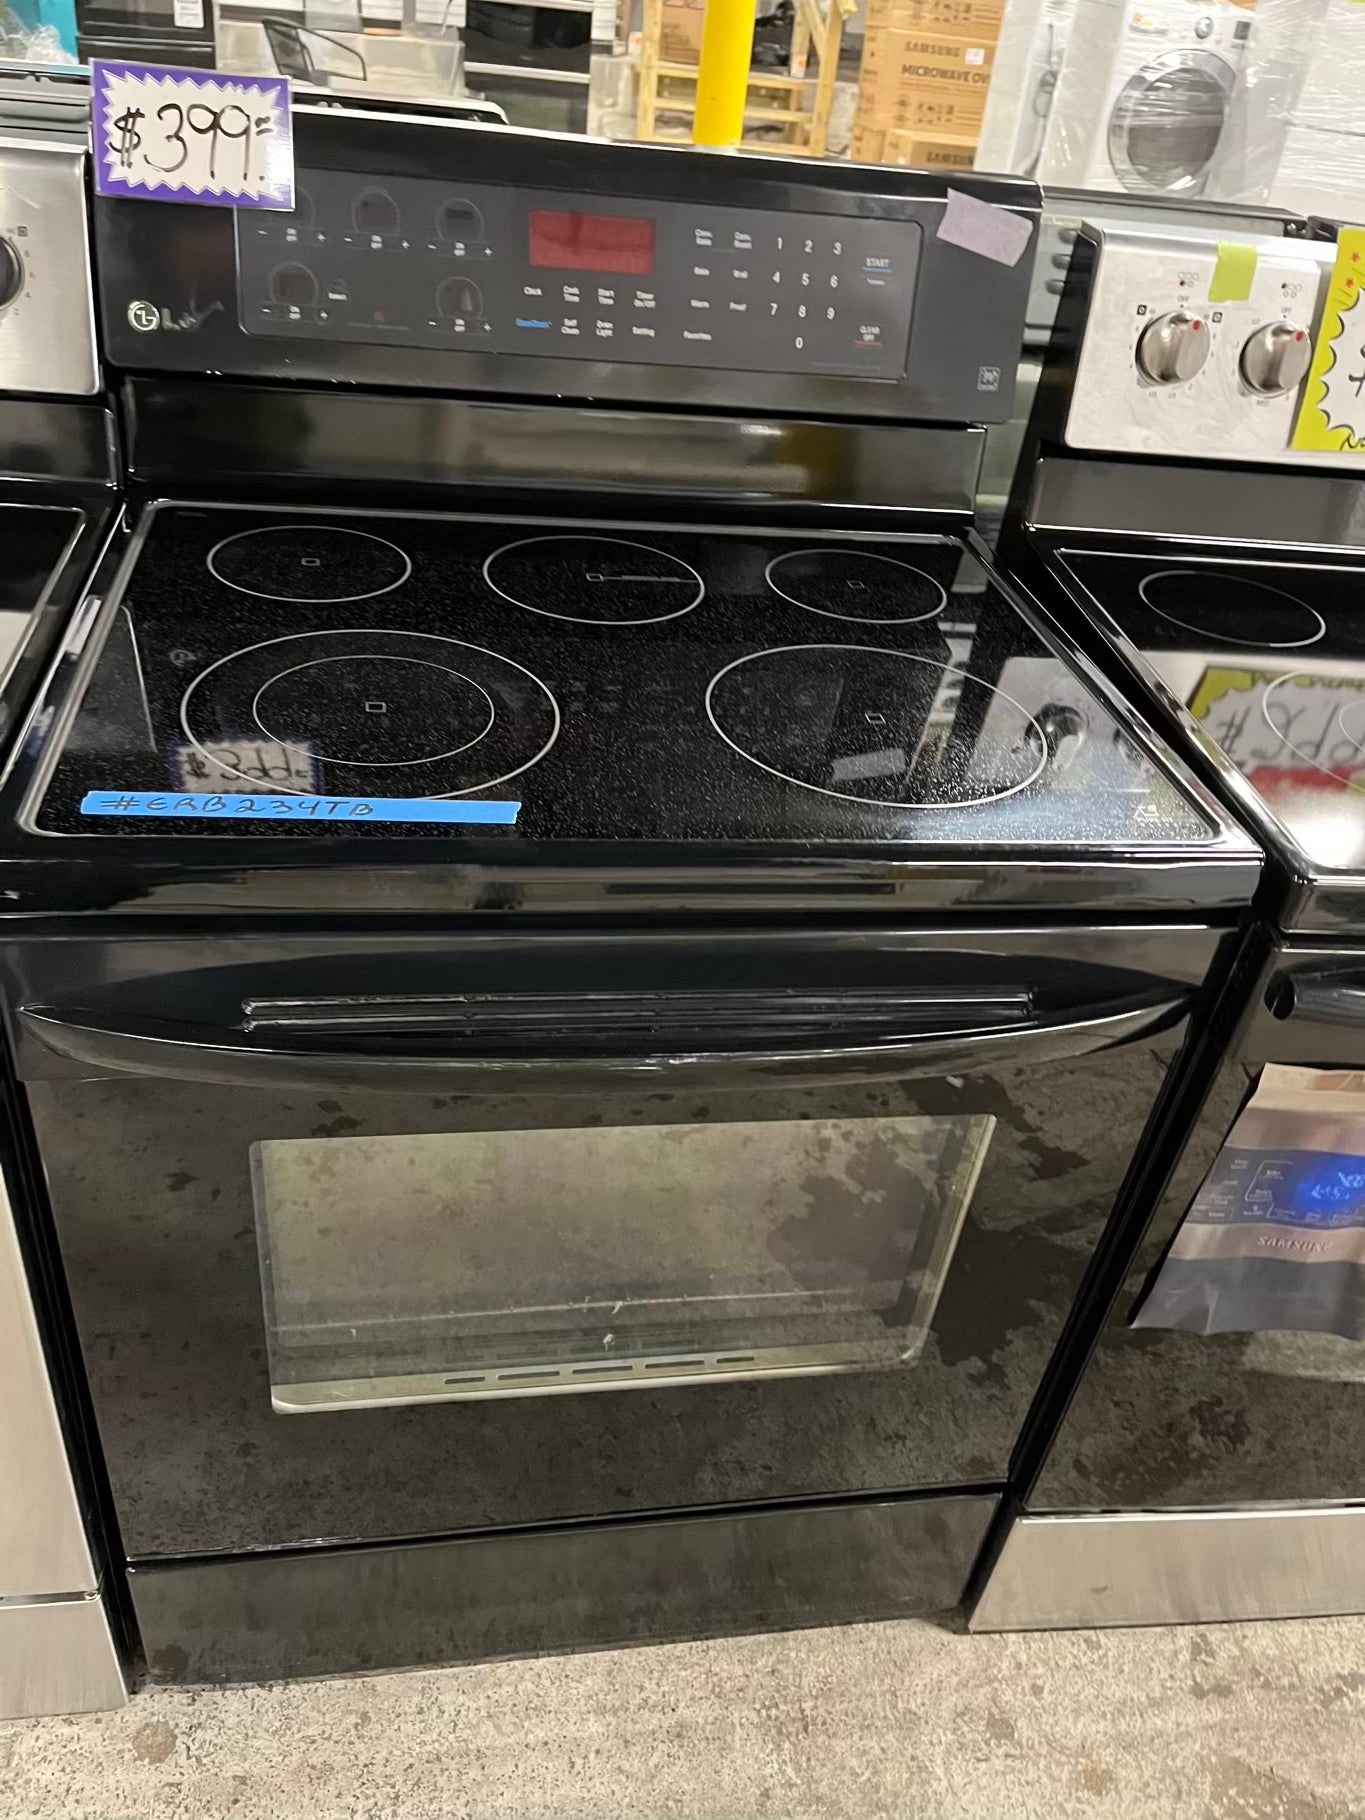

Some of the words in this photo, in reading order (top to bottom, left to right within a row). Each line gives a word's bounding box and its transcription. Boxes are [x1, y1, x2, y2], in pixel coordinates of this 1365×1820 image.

[902, 64, 970, 82] MICROWAVE
[777, 237, 783, 250] 1
[805, 239, 813, 253] 2
[833, 241, 842, 255] 3
[865, 257, 890, 268] START
[772, 271, 780, 284] 4
[801, 273, 810, 286] 5
[830, 275, 839, 288] 6
[769, 302, 778, 316] 7
[798, 305, 807, 318] 8
[827, 307, 836, 320] 9
[795, 336, 804, 349] 0
